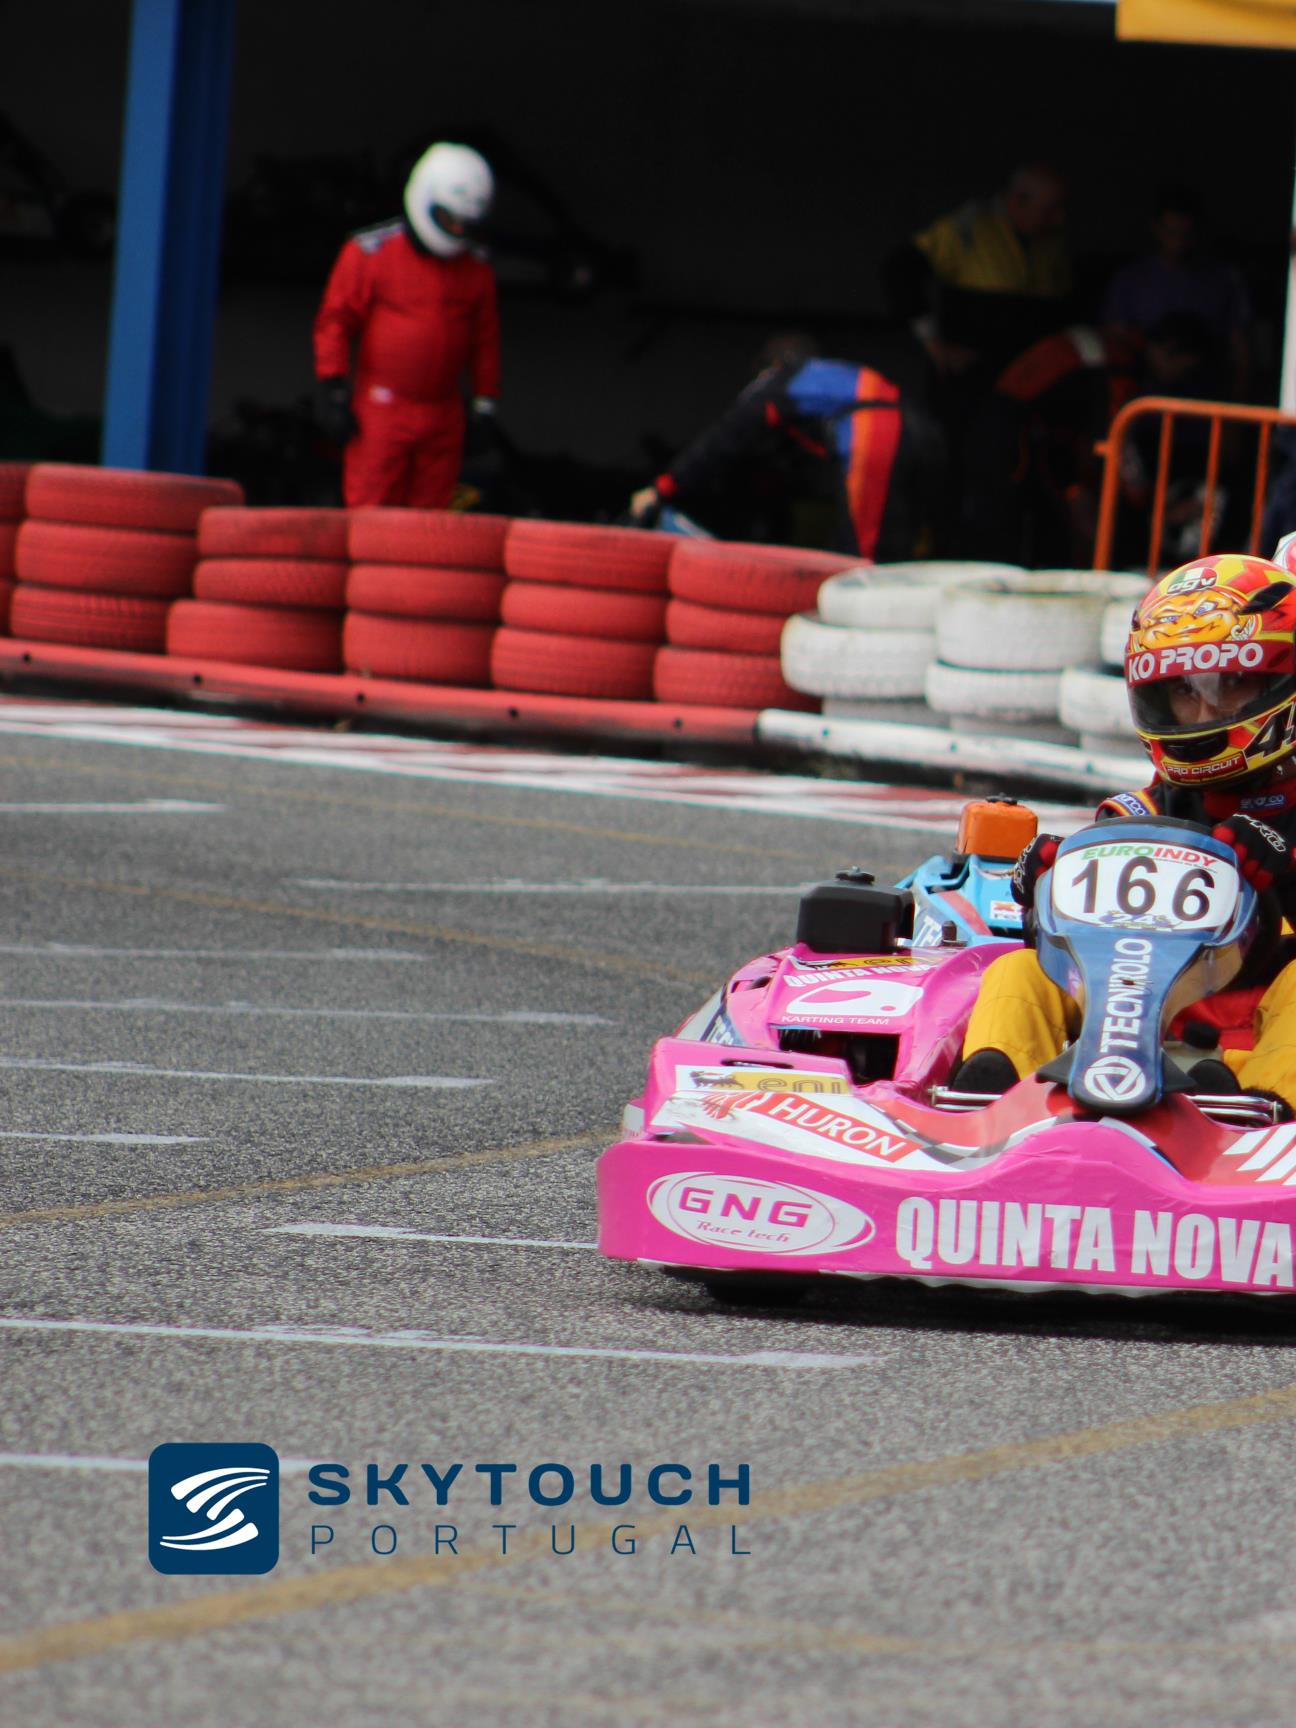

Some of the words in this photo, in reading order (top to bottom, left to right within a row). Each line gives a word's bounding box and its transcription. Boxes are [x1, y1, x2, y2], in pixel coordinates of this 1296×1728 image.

[1129, 654, 1155, 683] KO
[1159, 642, 1264, 674] PROPO
[1167, 766, 1188, 775] PRO
[1191, 757, 1240, 775] CIRCUIT
[1081, 845, 1217, 867] EUROINDY
[1071, 856, 1215, 922] 166
[783, 968, 871, 987] QUINTA
[781, 1015, 845, 1024] KARTING
[848, 1017, 891, 1025] TEAM
[757, 1077, 841, 1094] eni
[769, 1097, 907, 1158] HURON
[677, 1187, 815, 1229] GNG
[697, 1220, 744, 1238] Race
[747, 1225, 790, 1244] tech
[896, 1196, 1115, 1272] QUINTA
[1132, 1209, 1294, 1287] NOVA
